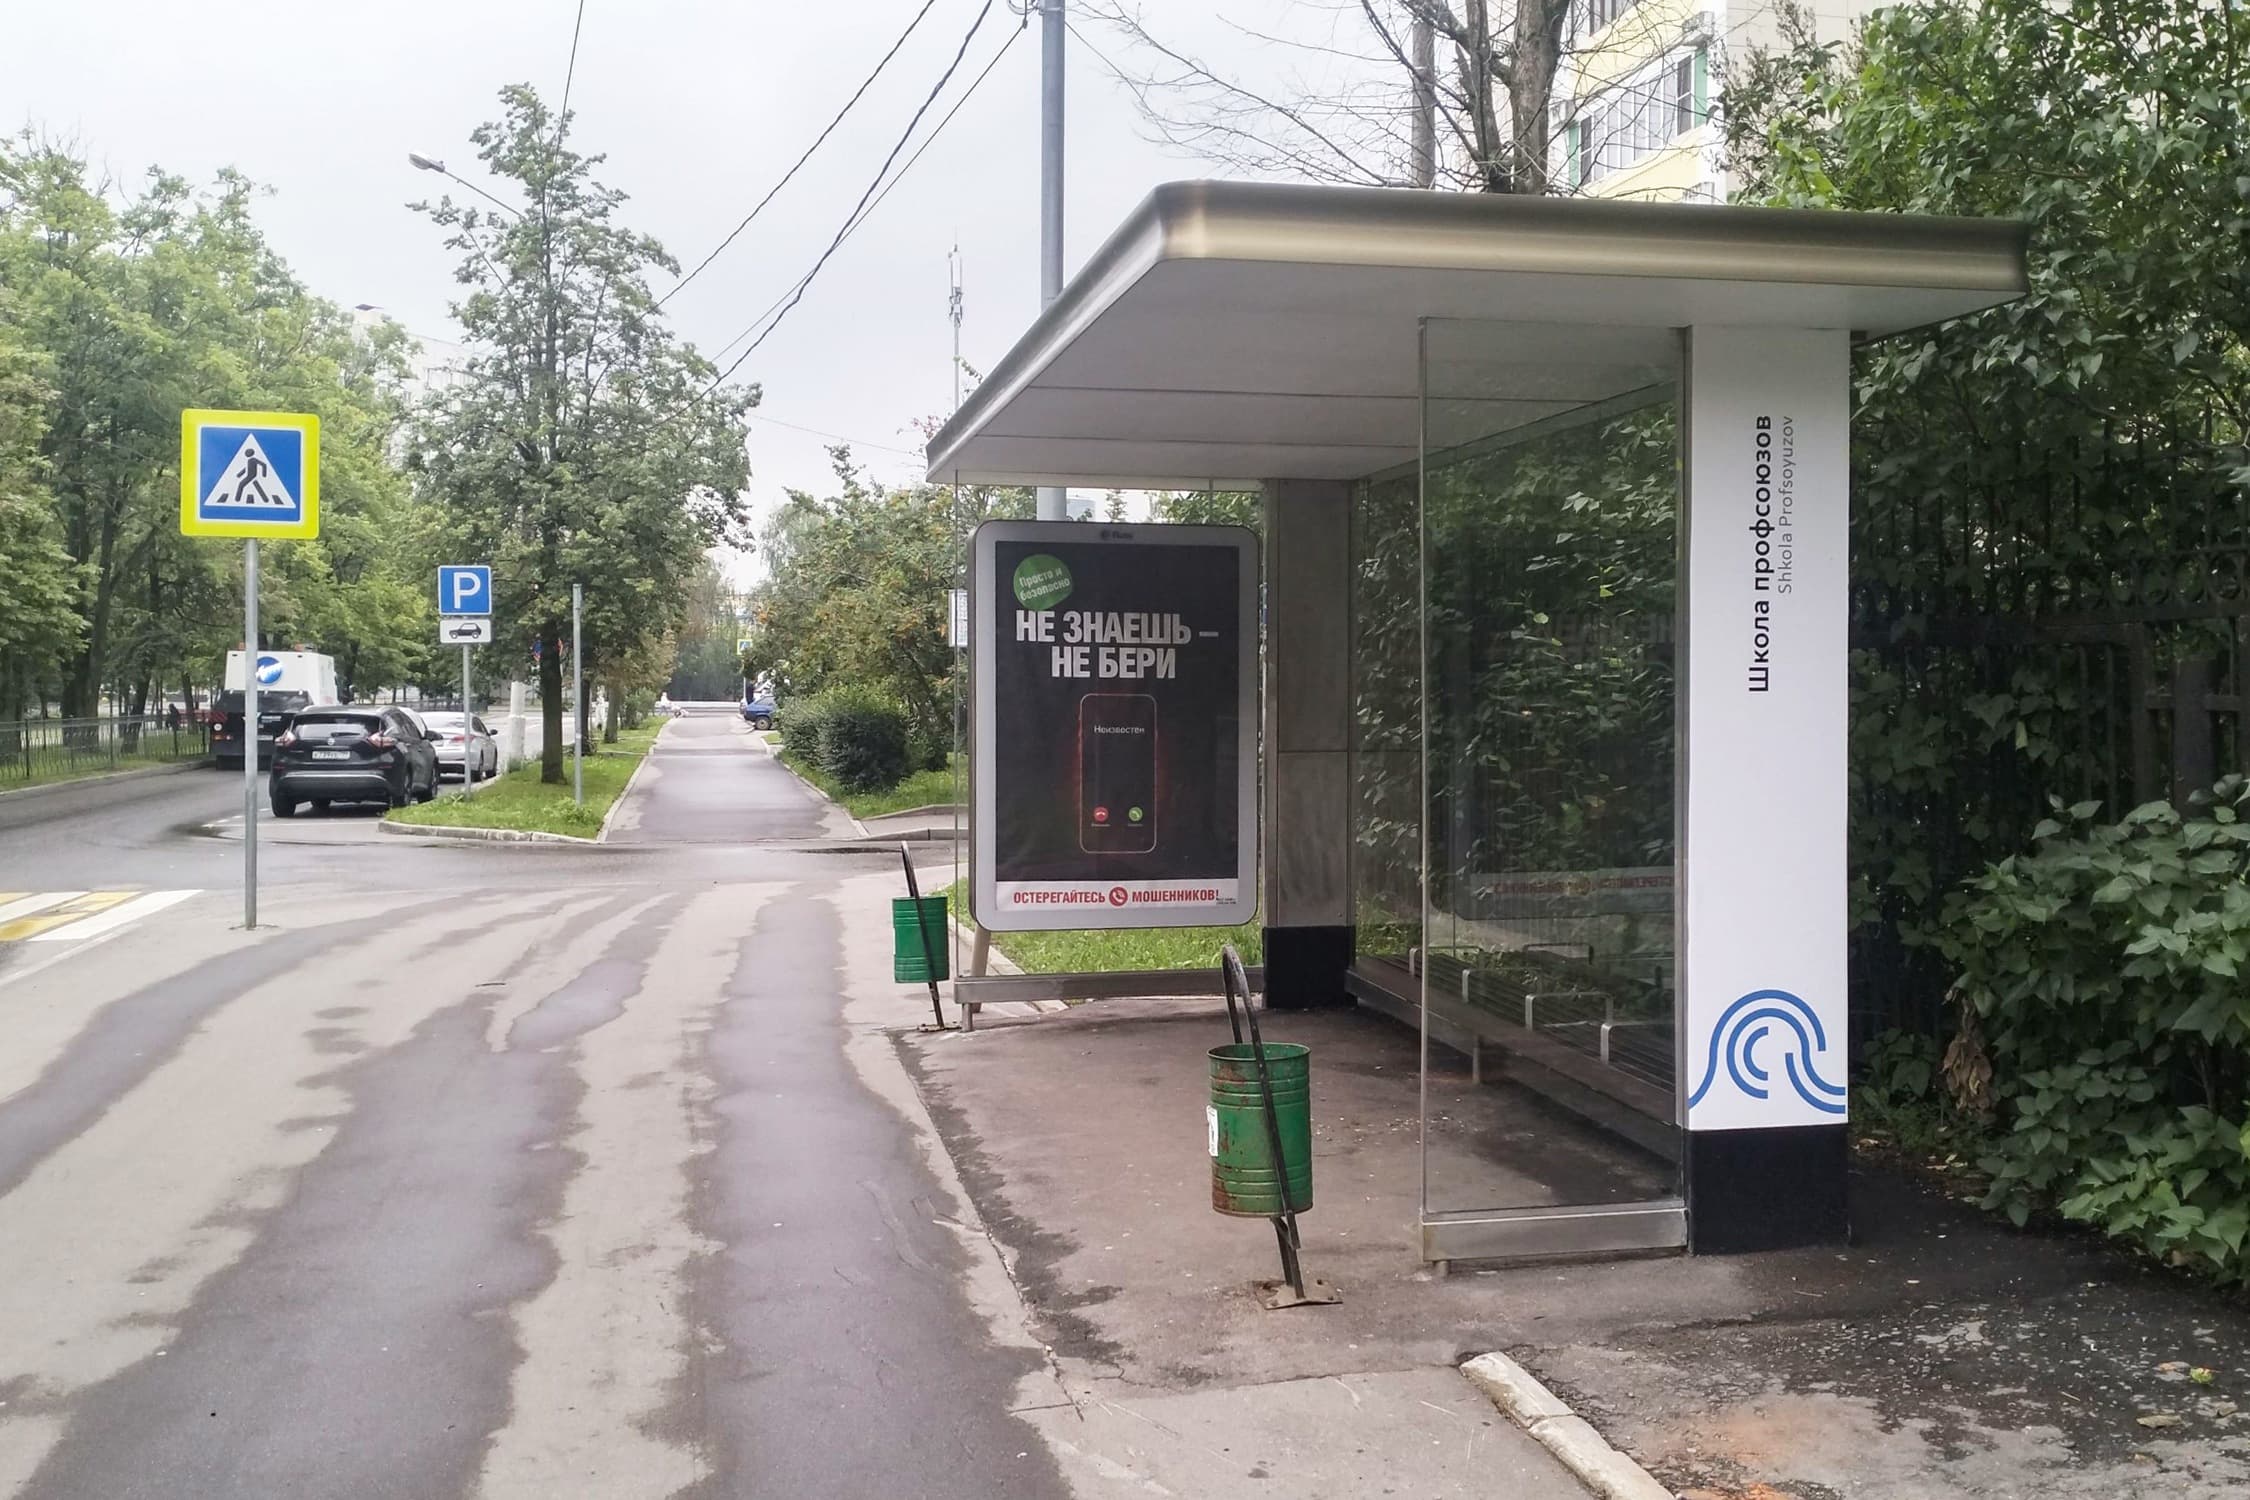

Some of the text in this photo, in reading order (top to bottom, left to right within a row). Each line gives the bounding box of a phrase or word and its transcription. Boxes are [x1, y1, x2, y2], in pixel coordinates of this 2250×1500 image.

[1778, 415, 1797, 595] Shkola Profsoyuzov
[1749, 415, 1775, 692] Школа профсоюзов
[453, 572, 481, 609] P
[1019, 569, 1054, 588] Просто
[1016, 610, 1055, 642] НЕ
[1063, 610, 1192, 645] ЗНАЕШЬ
[1051, 646, 1176, 680] НЕ БЕРИ
[1013, 888, 1106, 904] ОСТЕРЕГАЙТЕСЬ
[1132, 889, 1219, 903] МОШЕННИКОВ!
